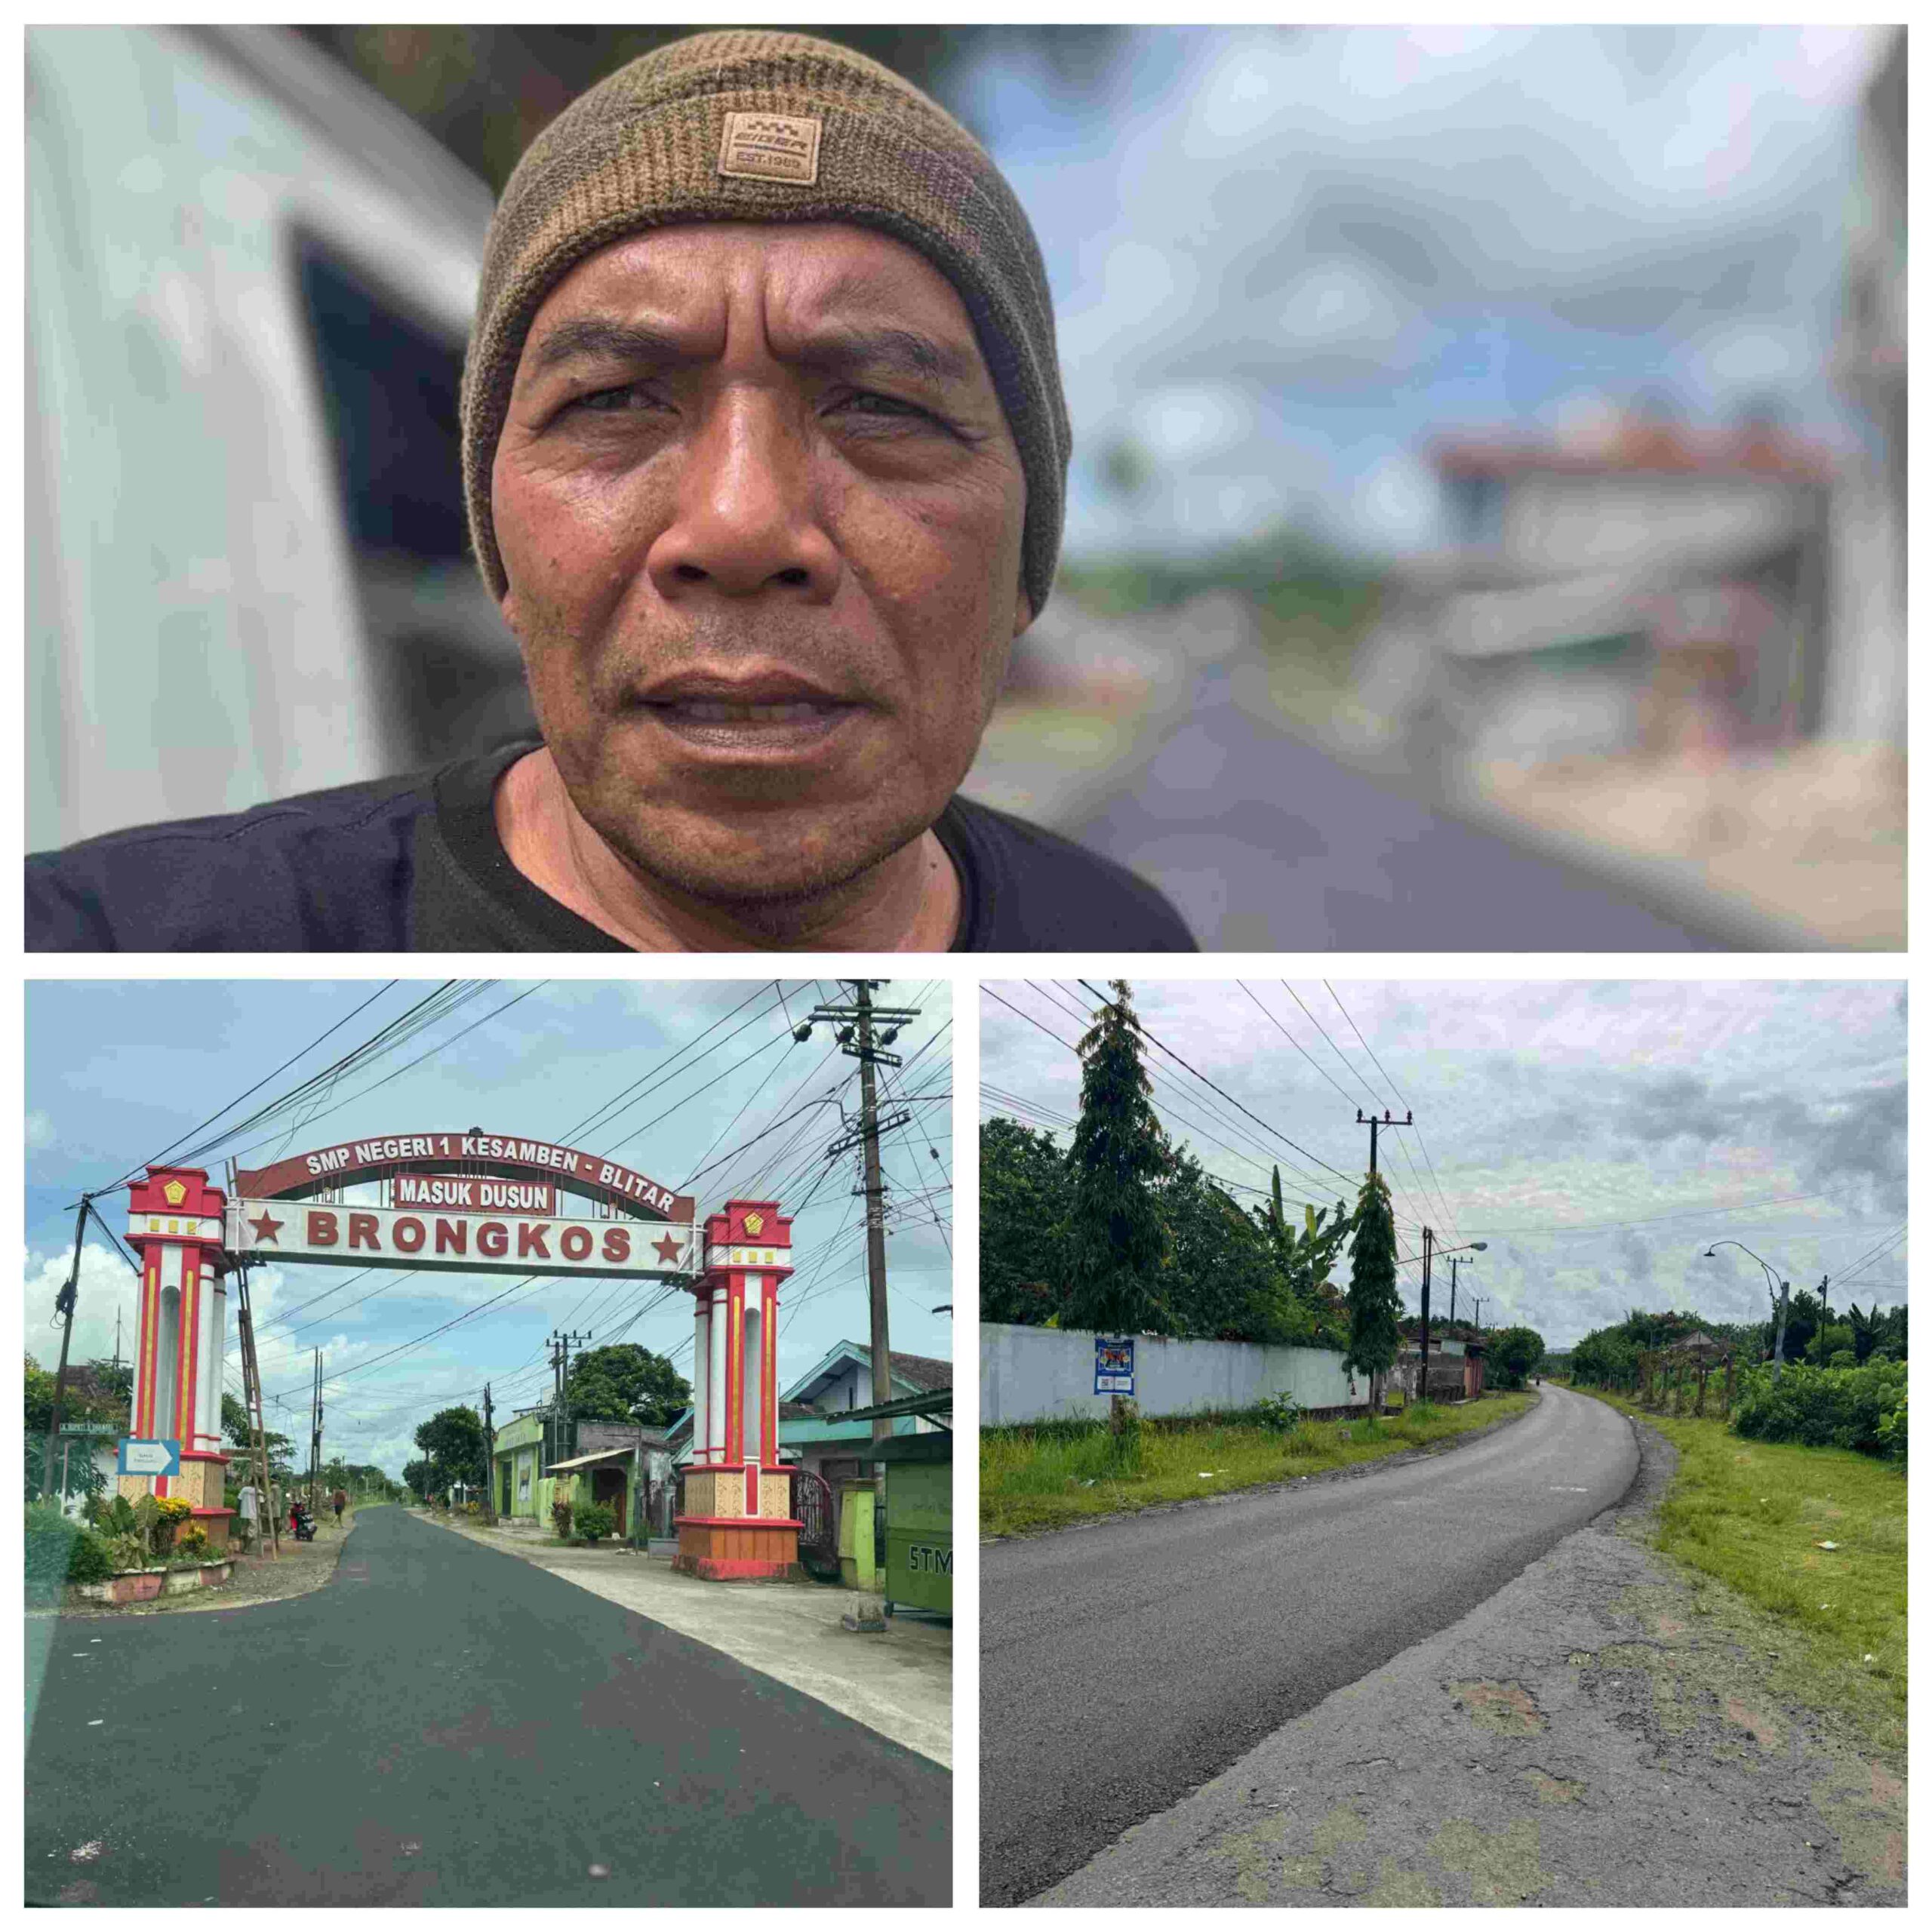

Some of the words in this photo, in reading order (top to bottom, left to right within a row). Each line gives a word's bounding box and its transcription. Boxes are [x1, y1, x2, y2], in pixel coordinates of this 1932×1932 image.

[306, 1148, 350, 1175] SMP
[355, 1137, 434, 1164] NEGERI
[439, 1137, 450, 1156] 1
[461, 1137, 579, 1172] KESAMBEN
[599, 1164, 675, 1214] BLITAR
[400, 1179, 472, 1205] MASUK
[480, 1184, 547, 1209] DUSUN
[307, 1211, 631, 1262] BRONGKOS
